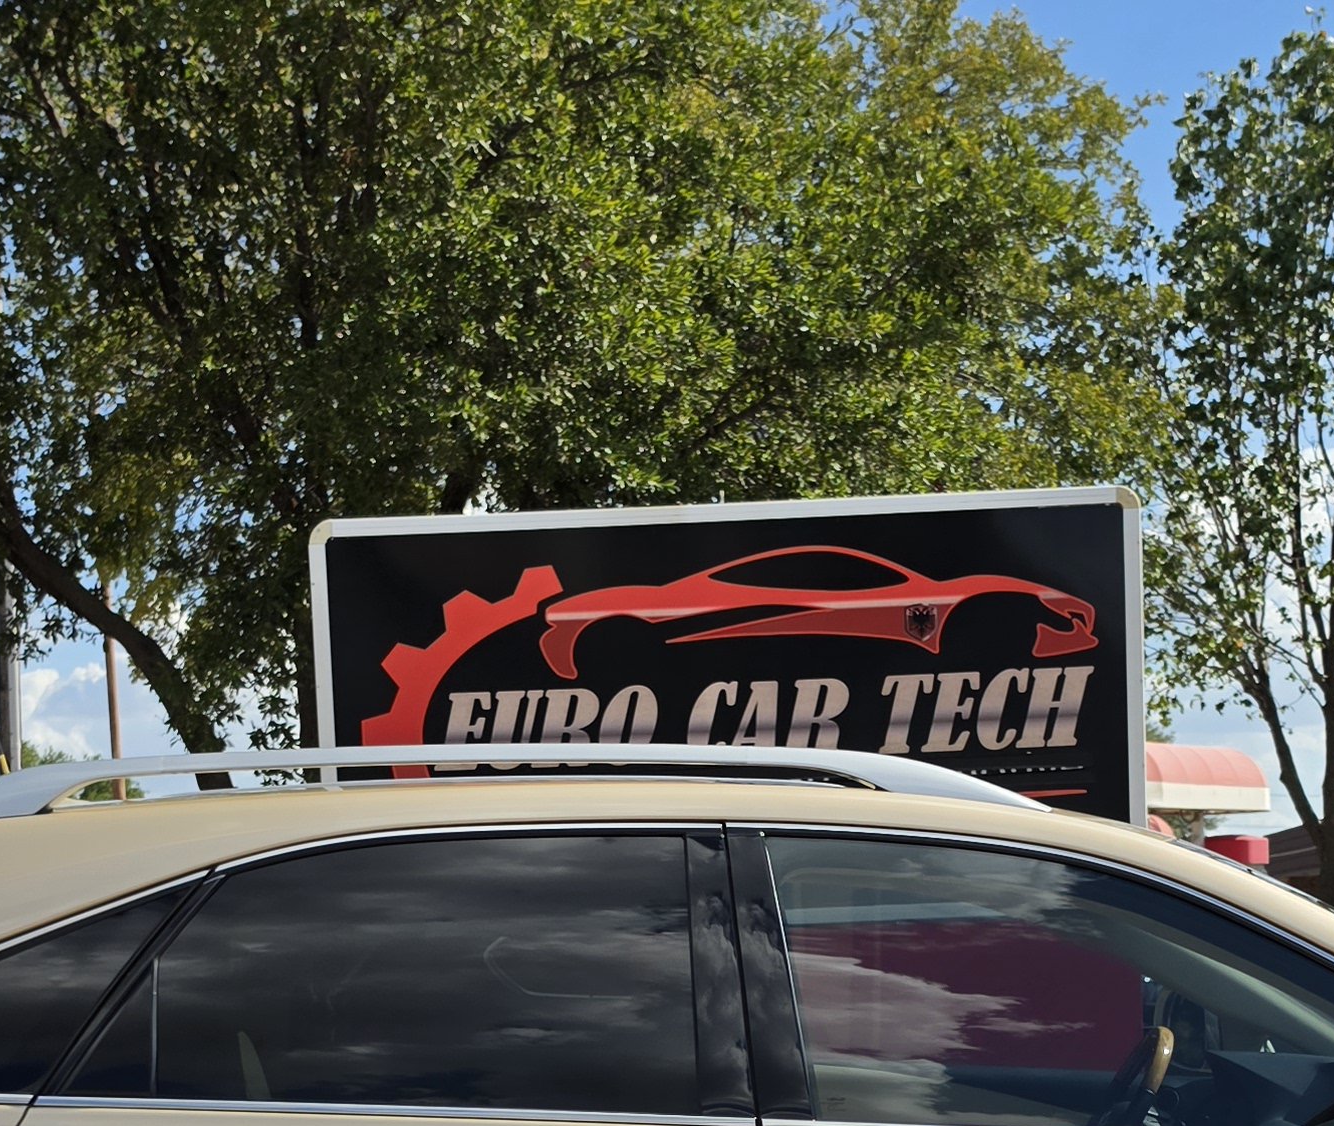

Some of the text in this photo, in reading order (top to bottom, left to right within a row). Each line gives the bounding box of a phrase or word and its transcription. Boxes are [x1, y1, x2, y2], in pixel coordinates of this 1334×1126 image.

[434, 666, 1095, 771] EURO CAR TECH
